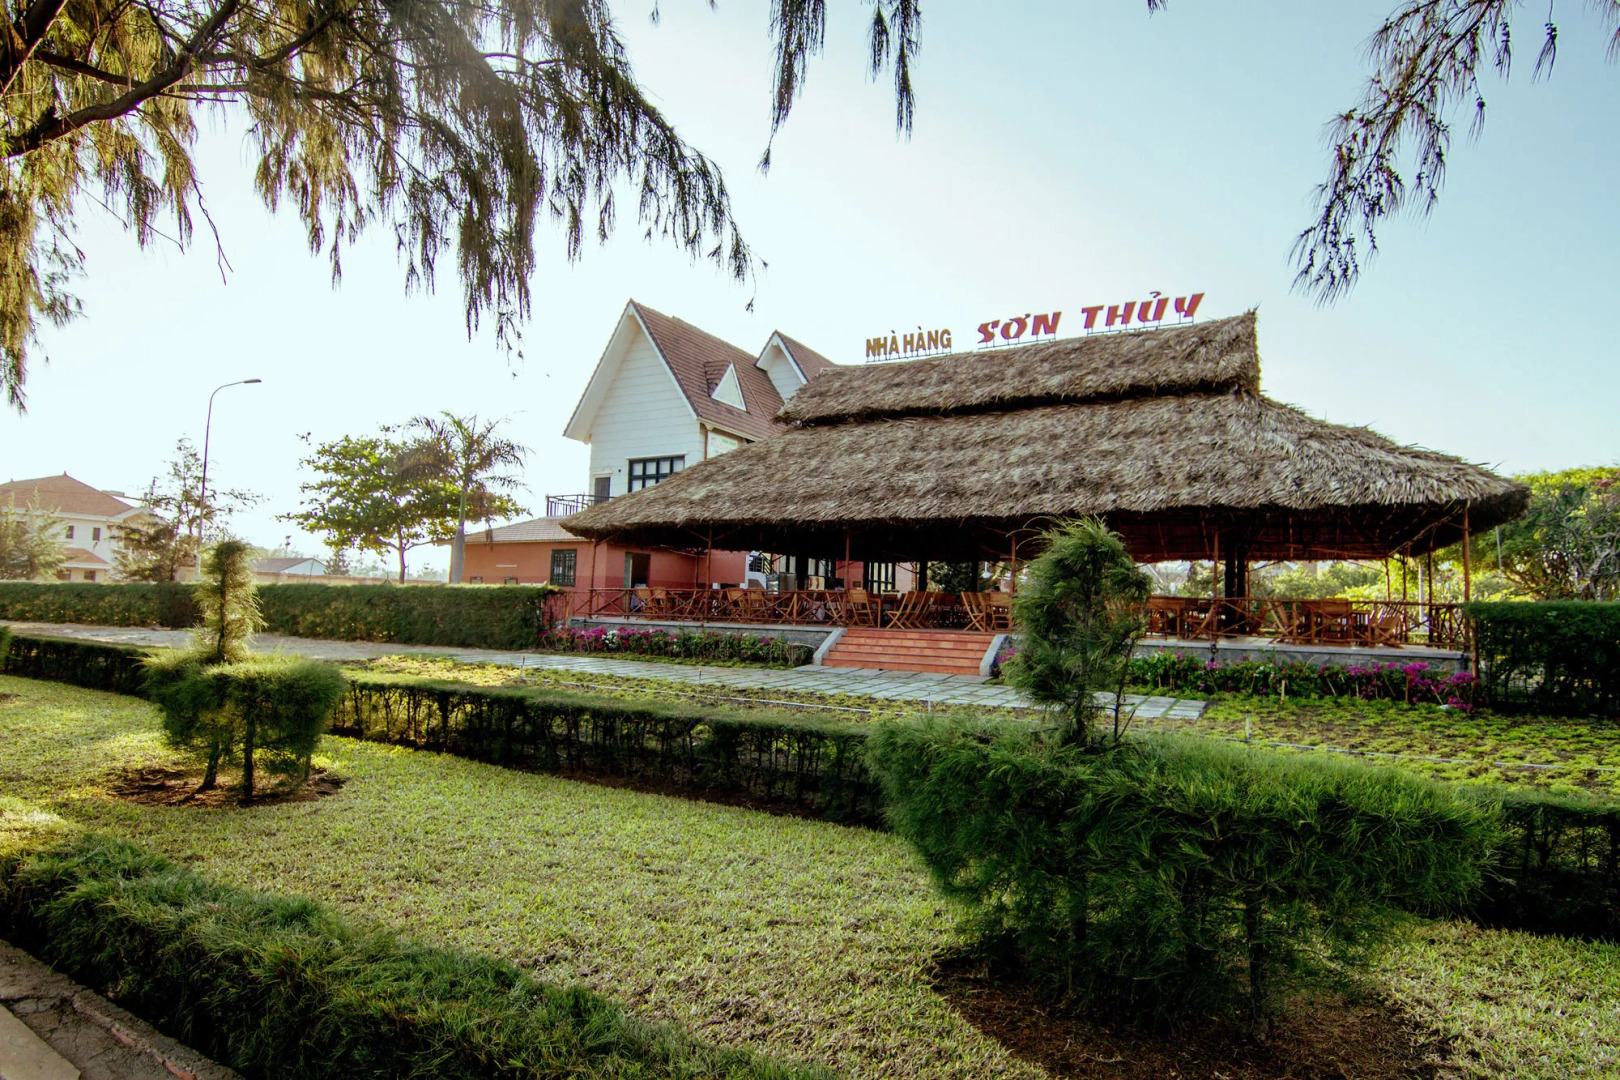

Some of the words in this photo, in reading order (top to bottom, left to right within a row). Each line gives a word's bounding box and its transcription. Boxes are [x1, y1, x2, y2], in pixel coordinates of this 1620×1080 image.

[866, 329, 900, 357] NHÀ
[903, 325, 952, 353] HÀNG
[1081, 291, 1205, 329] THỦY
